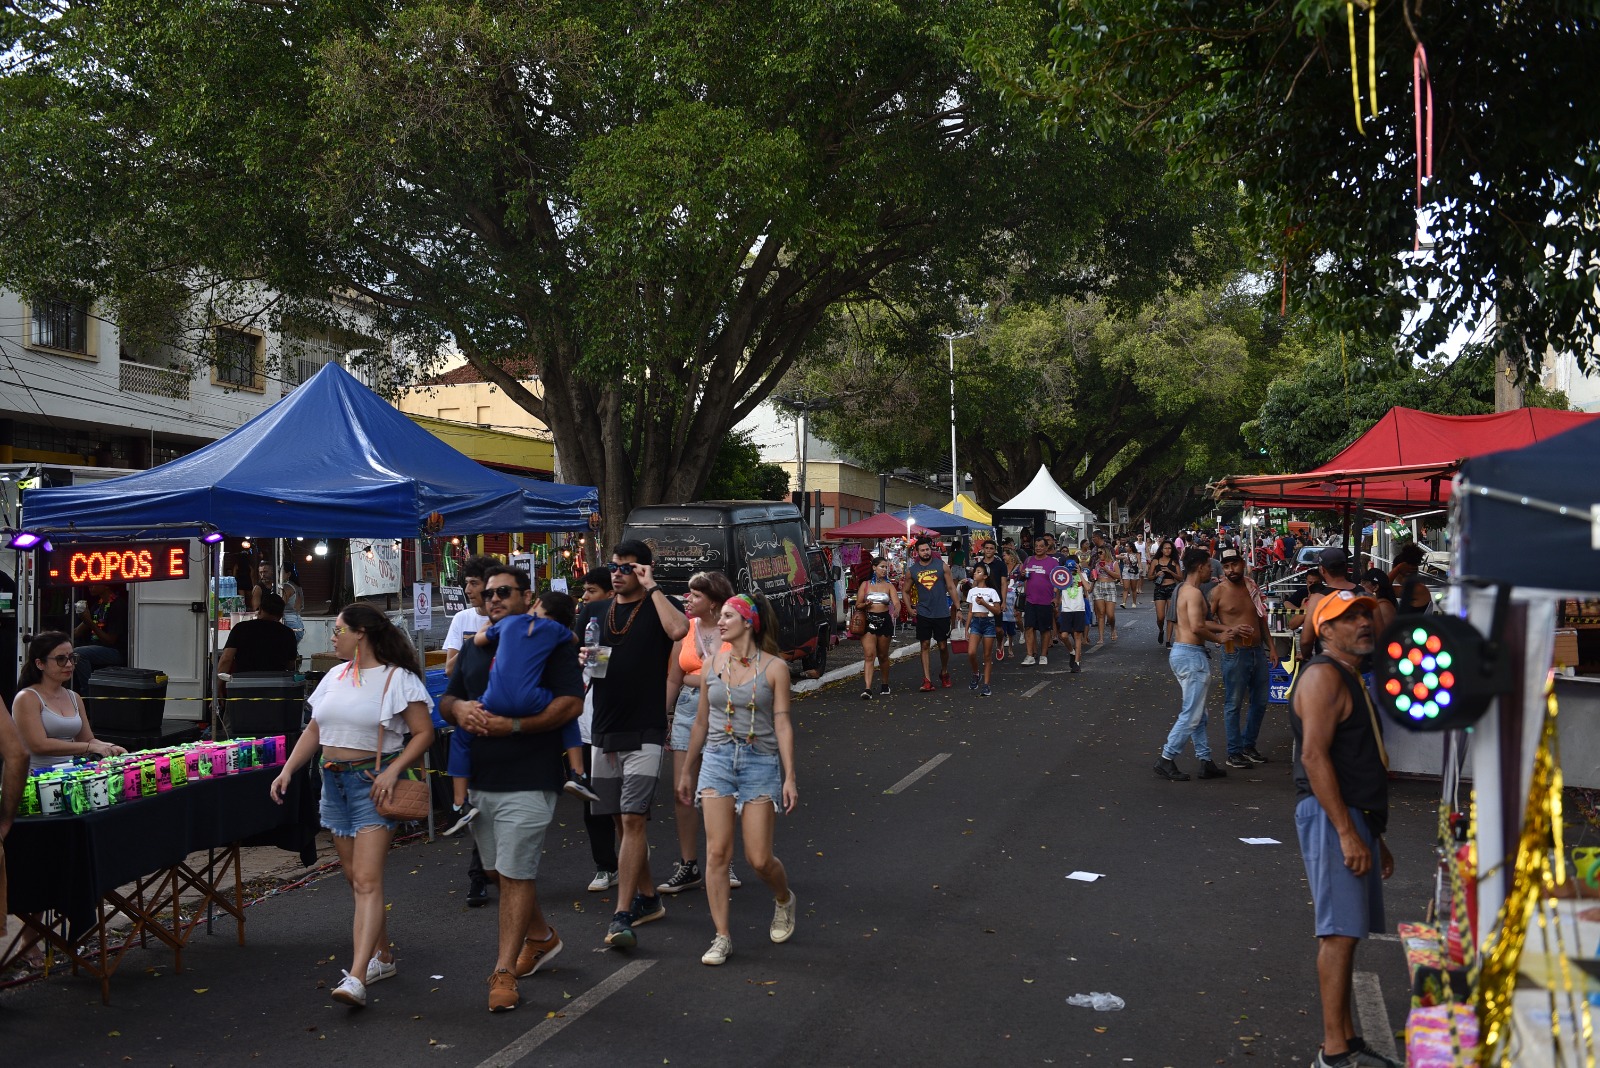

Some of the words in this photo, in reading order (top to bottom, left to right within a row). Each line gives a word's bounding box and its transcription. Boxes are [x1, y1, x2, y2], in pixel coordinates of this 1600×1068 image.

[70, 550, 152, 582] COPOS
[170, 548, 184, 576] E
[751, 557, 773, 580] FIRE
